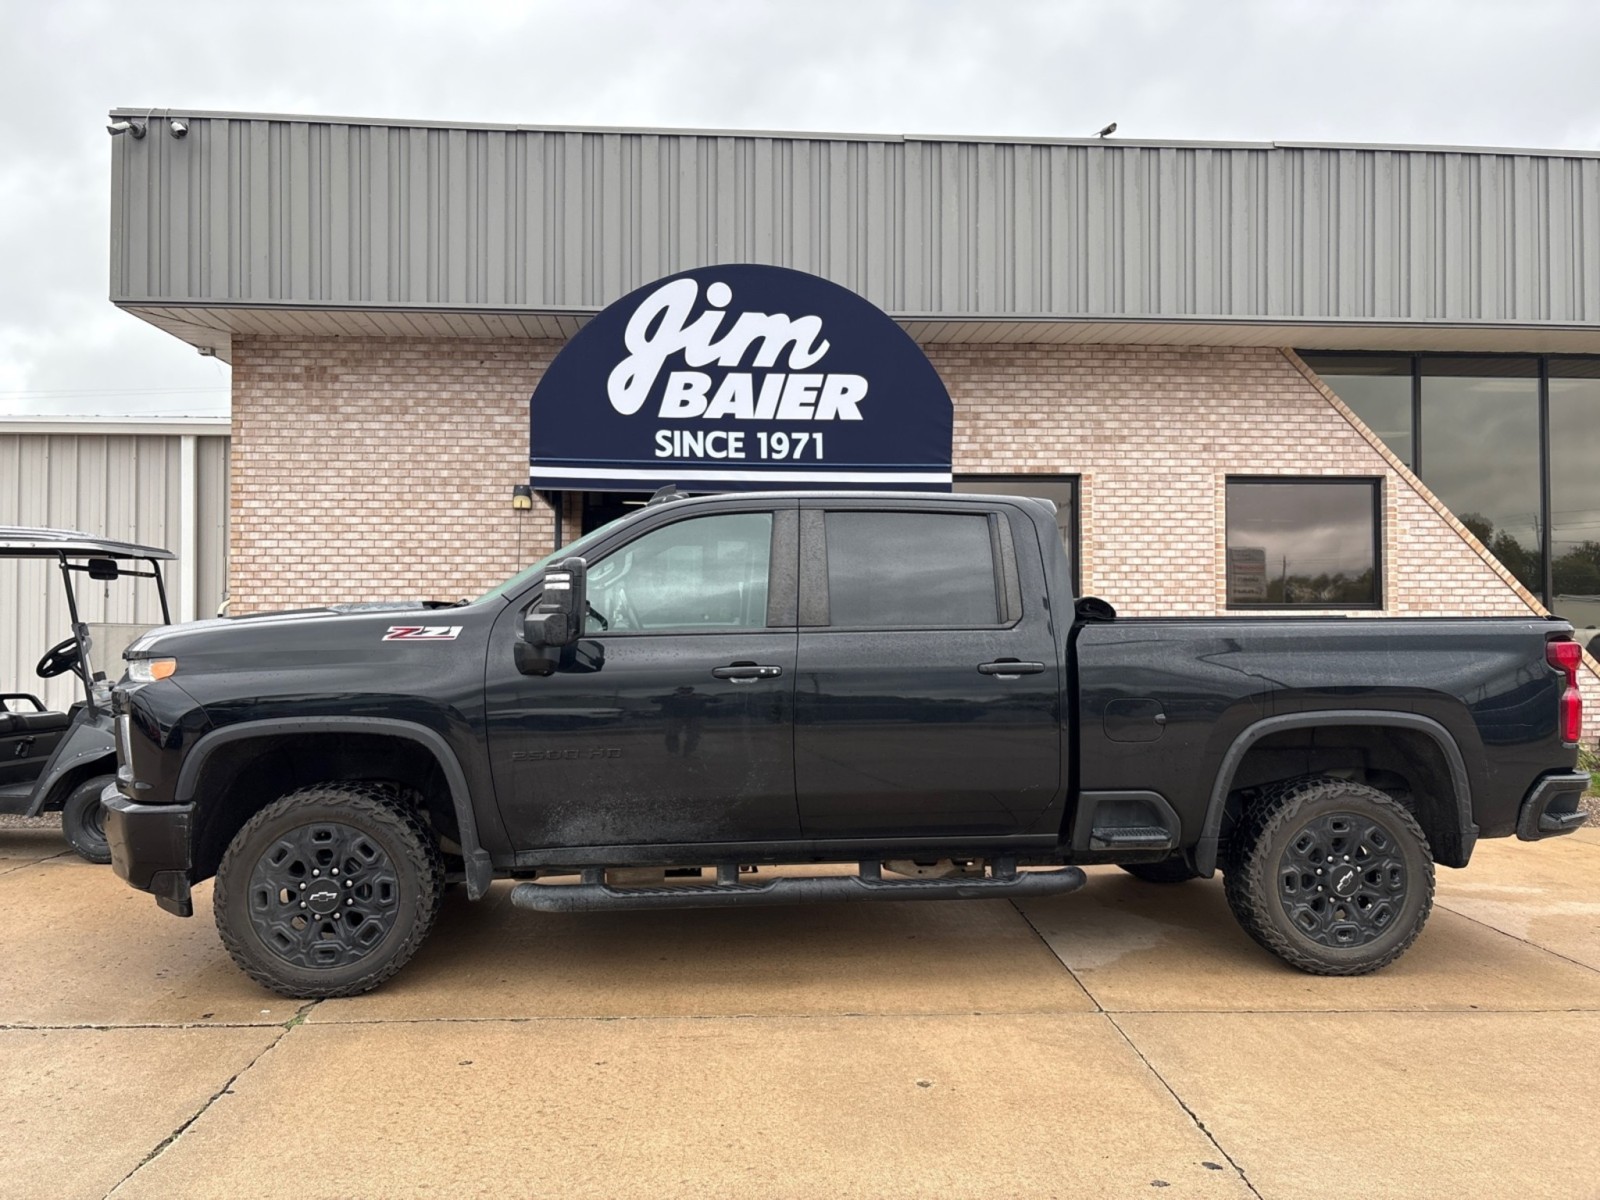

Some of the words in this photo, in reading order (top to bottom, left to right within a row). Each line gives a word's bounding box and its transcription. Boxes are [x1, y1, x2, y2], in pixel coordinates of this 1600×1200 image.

[607, 278, 831, 416] Jim
[657, 371, 869, 421] BAIER
[655, 429, 746, 459] SINCE
[756, 431, 824, 460] 1971
[381, 625, 464, 642] Z71
